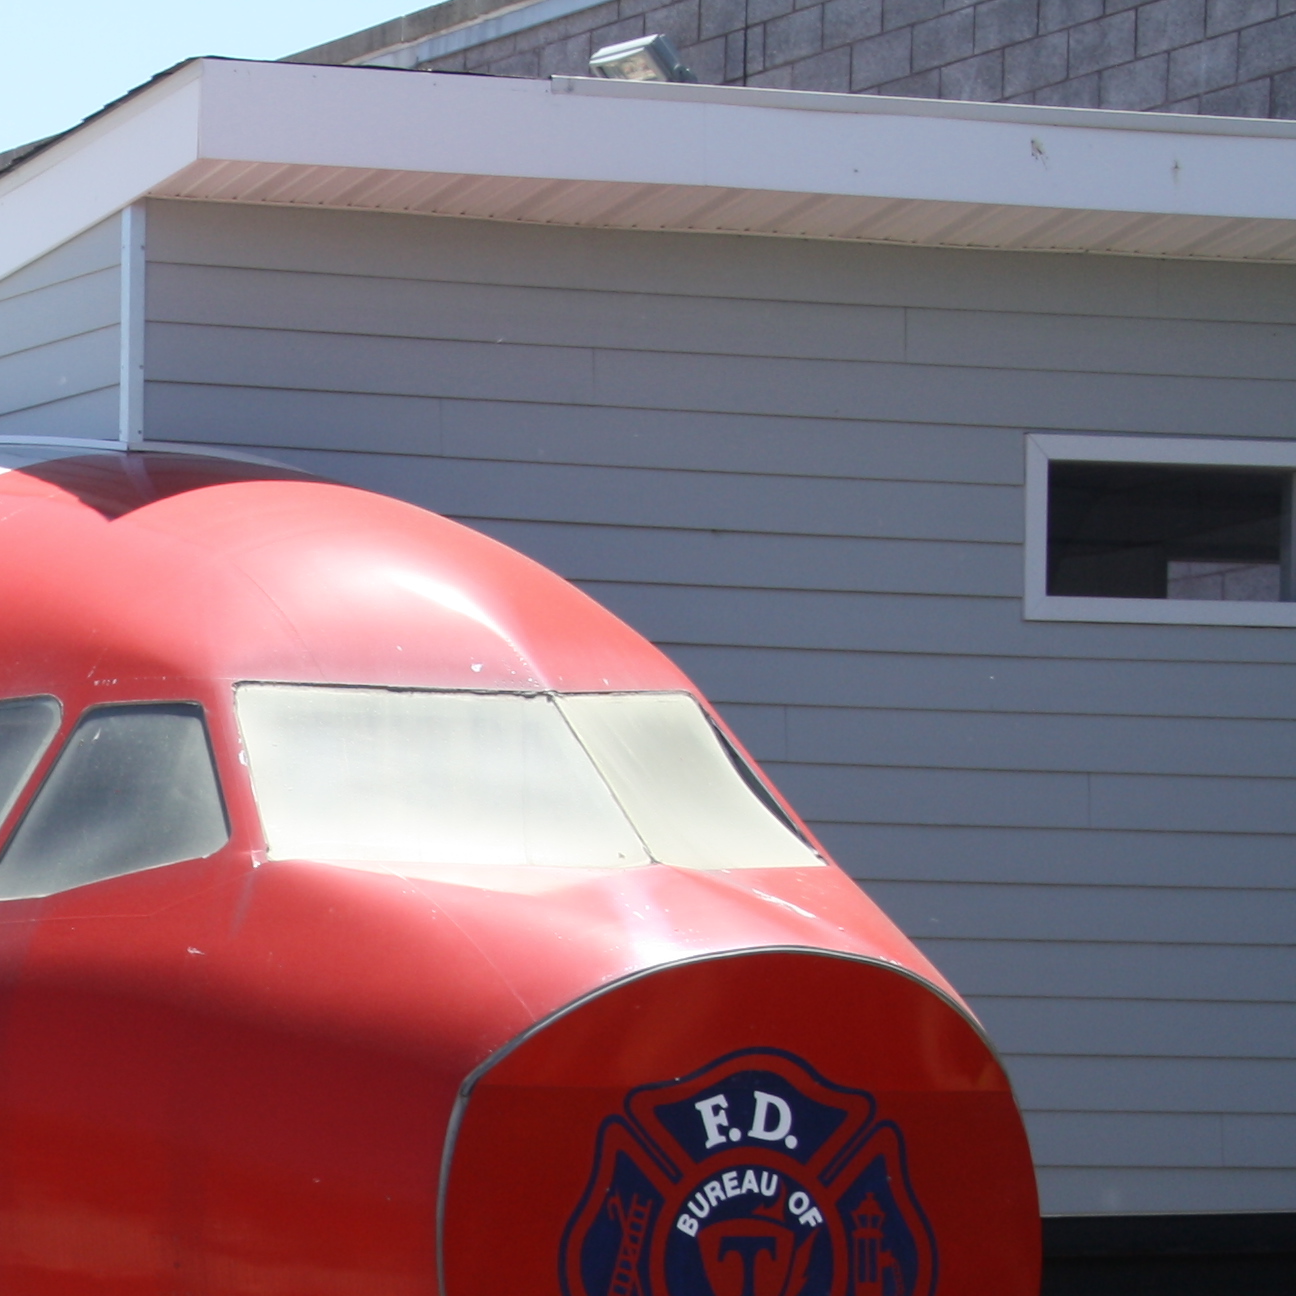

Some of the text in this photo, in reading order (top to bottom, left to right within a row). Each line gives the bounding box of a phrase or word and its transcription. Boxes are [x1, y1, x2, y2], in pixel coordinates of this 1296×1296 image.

[695, 1090, 798, 1149] F.D.
[677, 1169, 824, 1238] BUREAU OF
